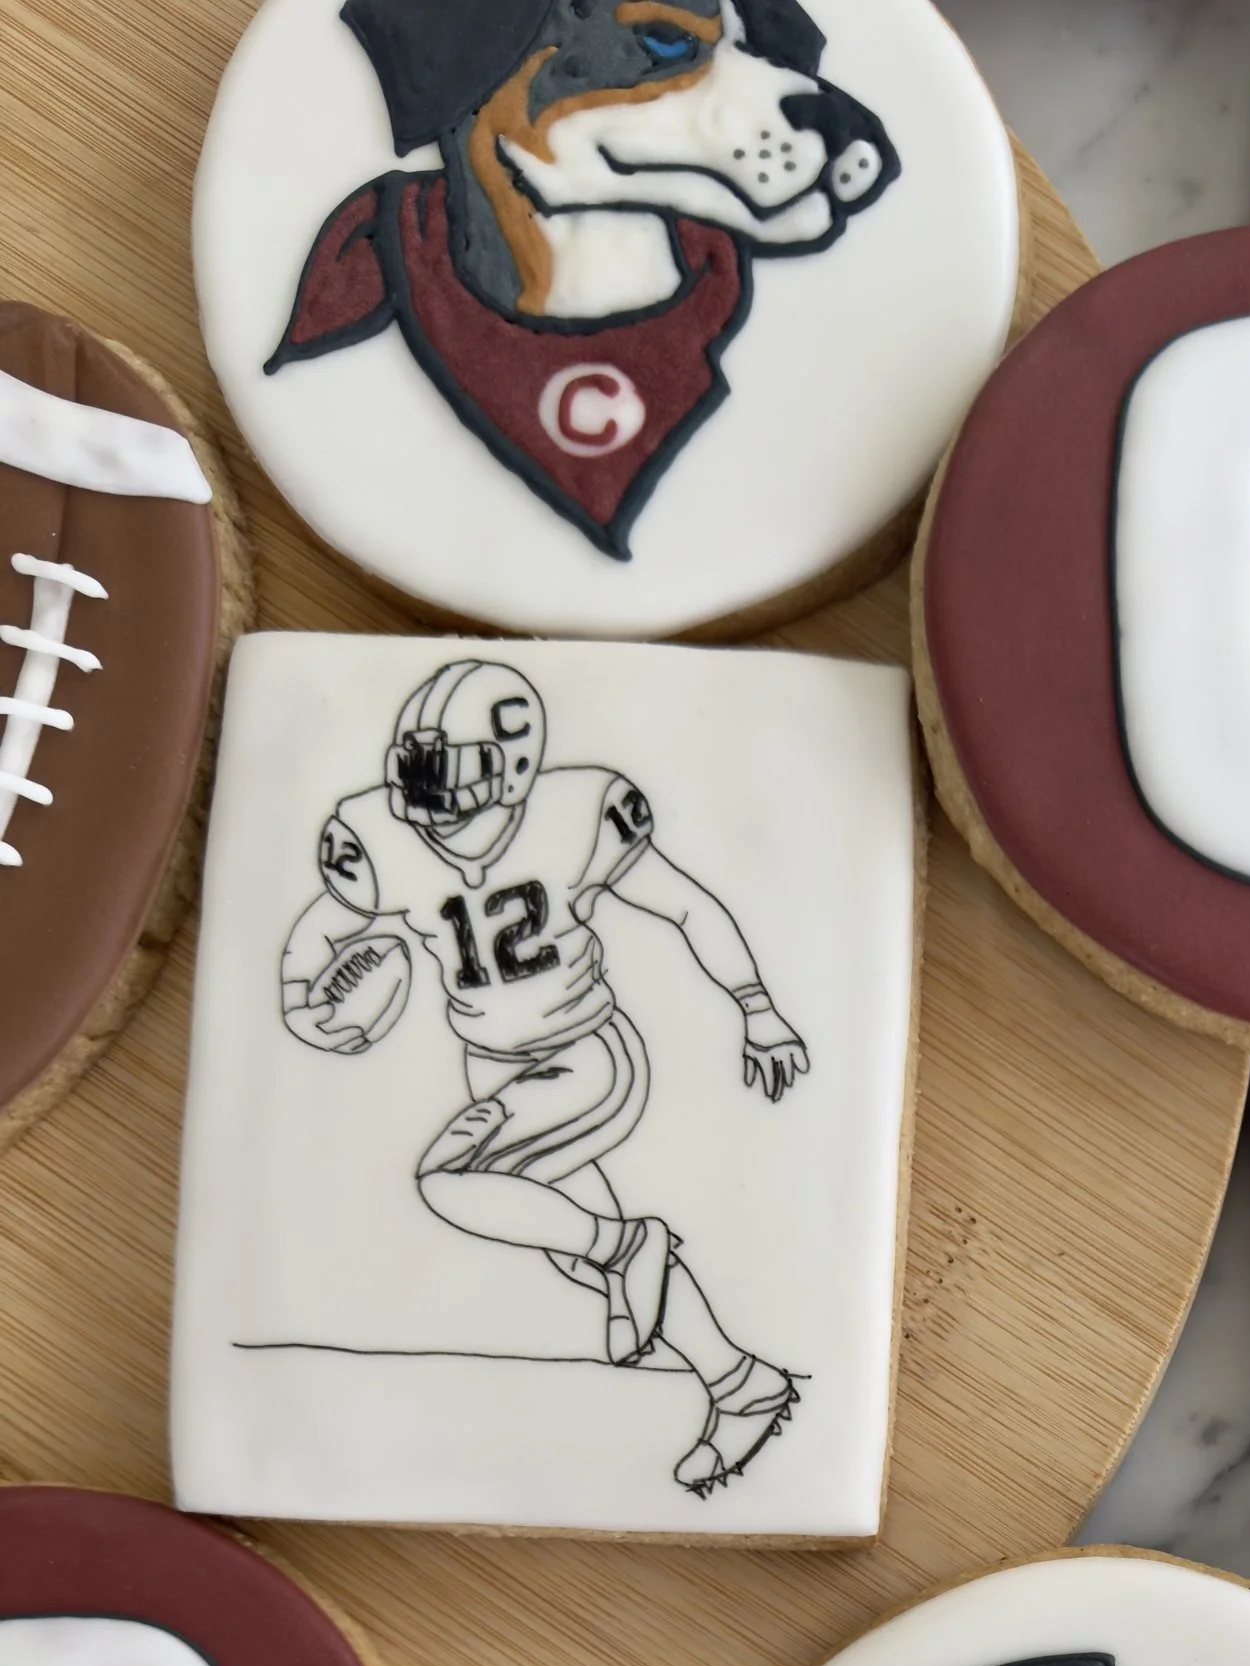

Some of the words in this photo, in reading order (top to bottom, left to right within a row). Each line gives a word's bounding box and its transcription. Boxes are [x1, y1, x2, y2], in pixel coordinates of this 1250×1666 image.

[557, 373, 621, 448] C
[491, 697, 531, 742] C
[604, 790, 652, 845] 12
[323, 831, 363, 882] 12
[440, 880, 560, 989] 12
